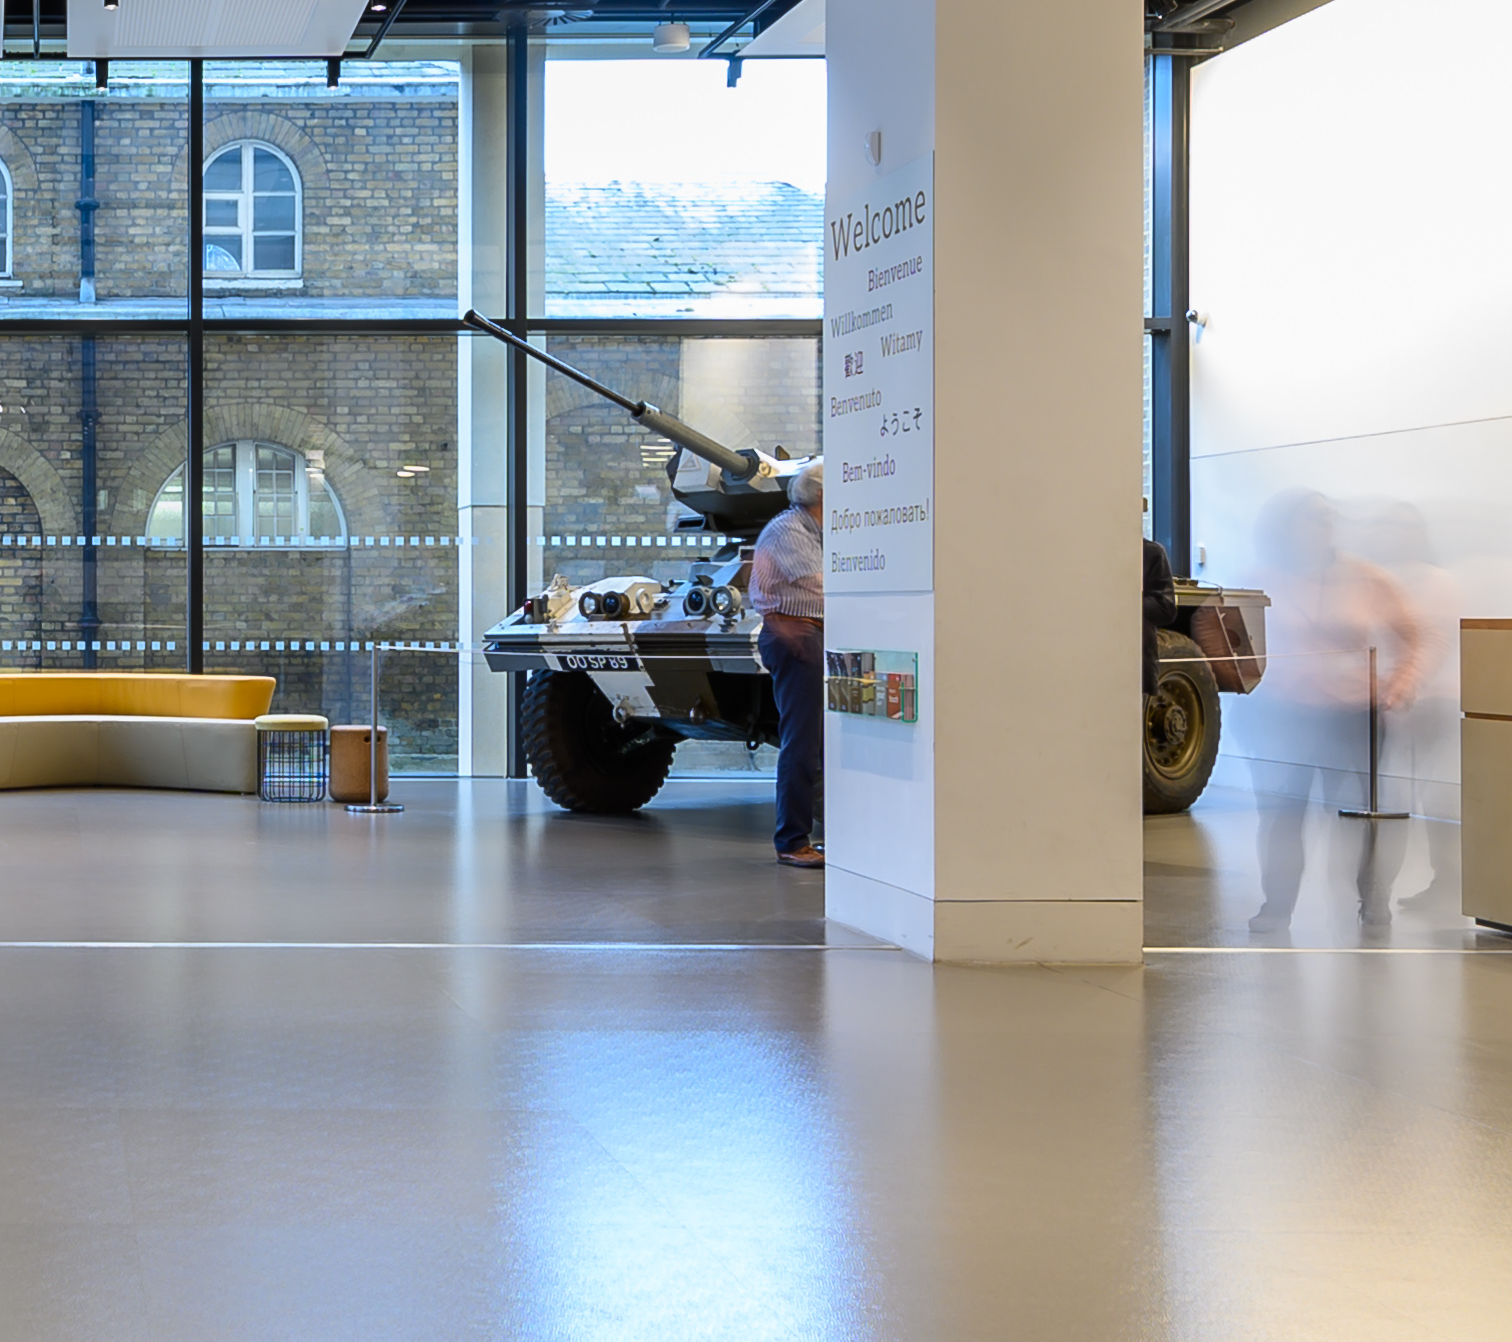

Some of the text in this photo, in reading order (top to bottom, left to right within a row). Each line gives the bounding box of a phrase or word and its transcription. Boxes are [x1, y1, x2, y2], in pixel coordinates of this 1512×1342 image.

[830, 190, 926, 261] Welcome
[868, 255, 923, 292] Bienvenue
[831, 303, 893, 339] Willkommen
[880, 330, 923, 358] Witamy
[830, 388, 882, 417] Benvenuto
[880, 407, 923, 437] ようこそ
[842, 454, 896, 483] Bem-vindo
[831, 498, 929, 534] Добро пожаловать!
[831, 549, 885, 573] Bienvenido
[609, 655, 628, 668] 89
